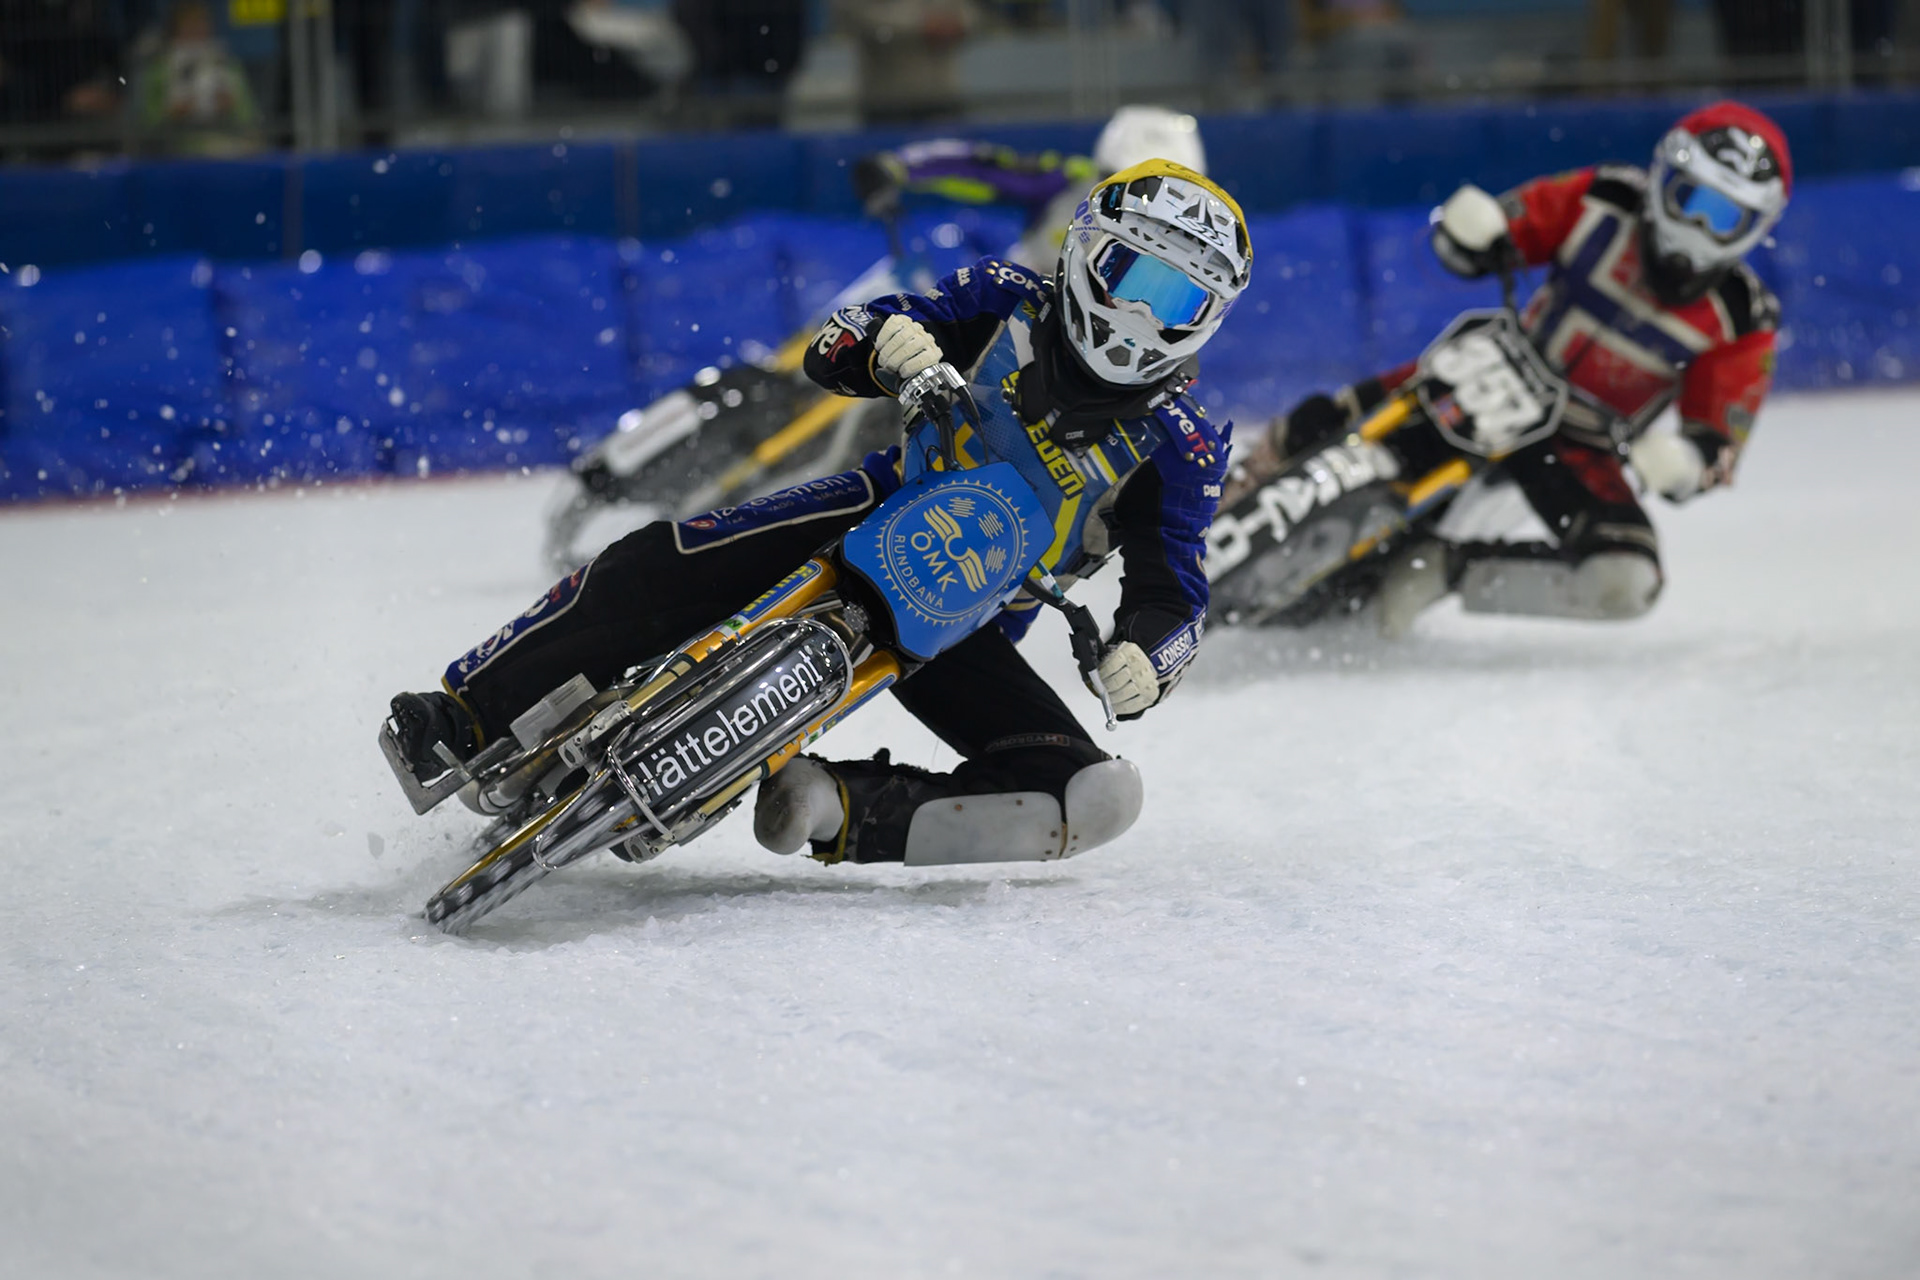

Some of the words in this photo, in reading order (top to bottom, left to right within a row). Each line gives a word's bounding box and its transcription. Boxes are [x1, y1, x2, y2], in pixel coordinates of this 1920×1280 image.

[1160, 399, 1210, 454] oreIT
[894, 534, 944, 609] RUNDBANA
[910, 530, 959, 594] ÖMK
[638, 649, 824, 796] lättelement
